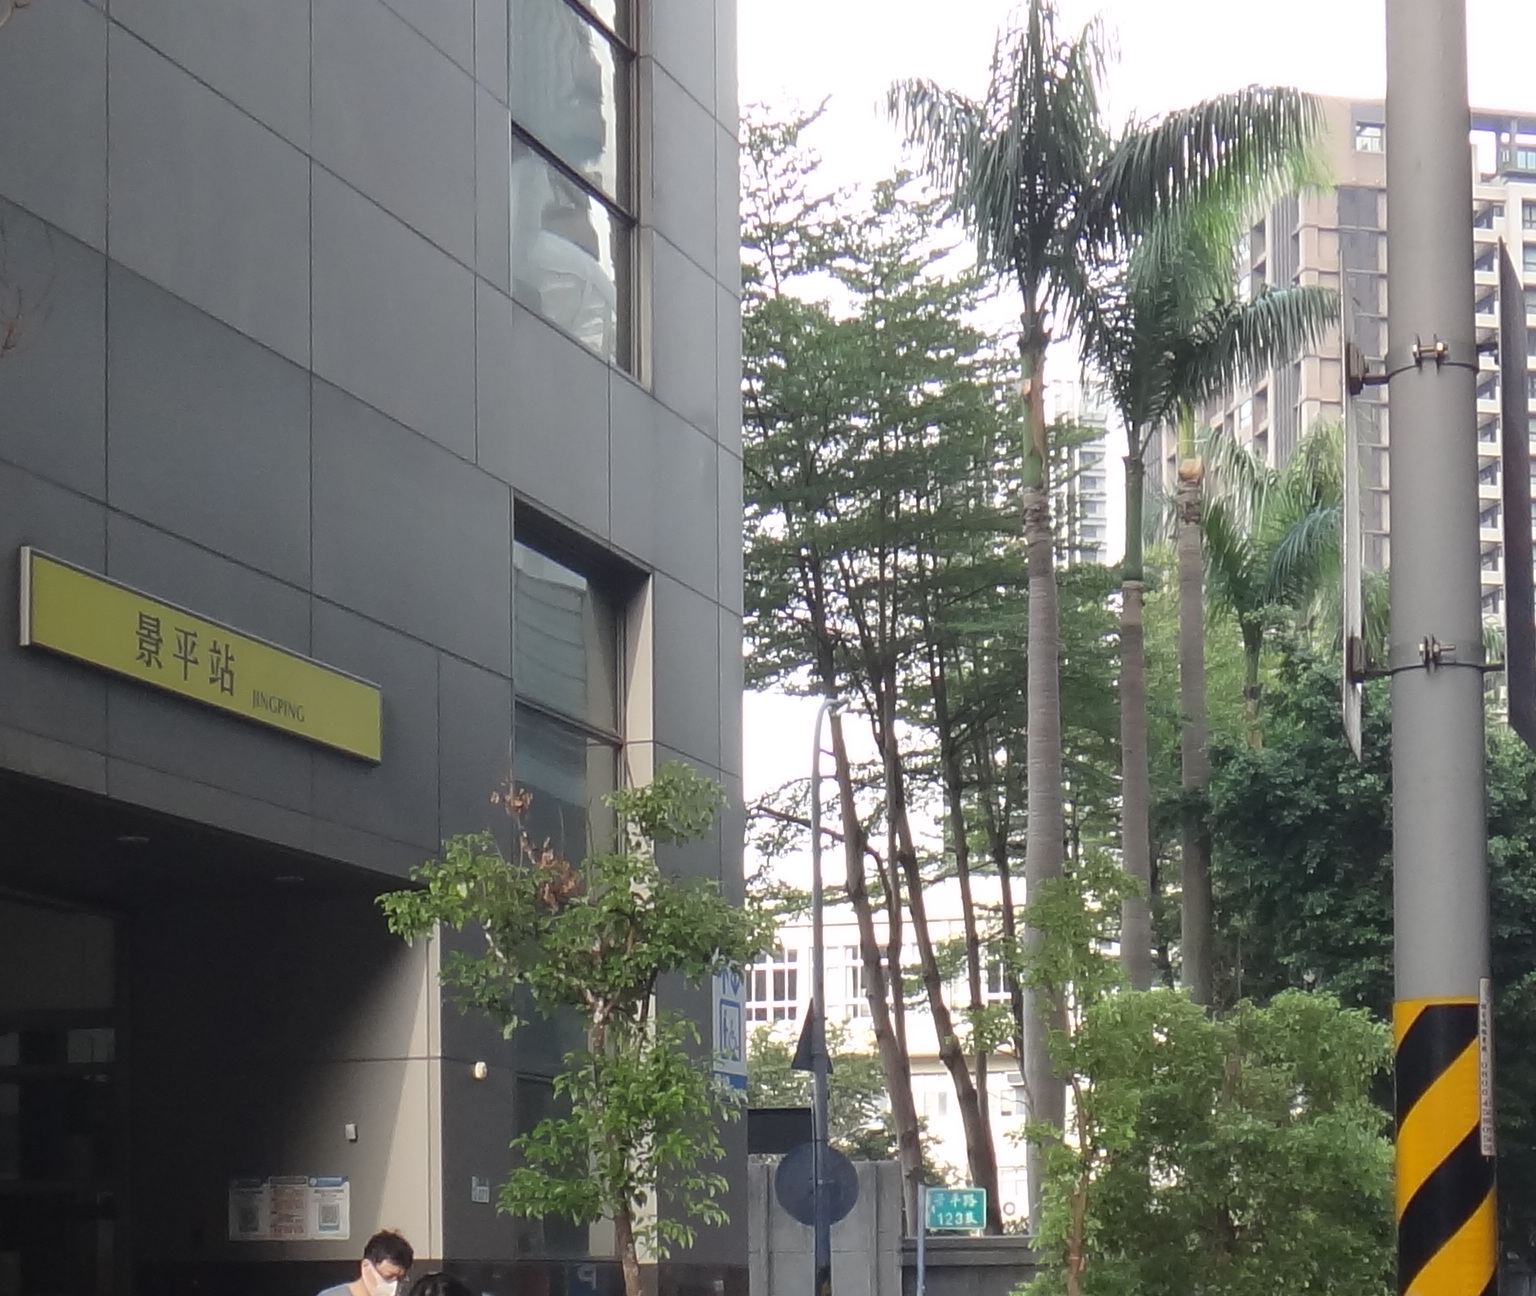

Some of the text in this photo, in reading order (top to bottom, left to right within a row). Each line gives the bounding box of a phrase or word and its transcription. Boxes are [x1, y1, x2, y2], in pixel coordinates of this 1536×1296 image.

[135, 610, 235, 697] 景平站
[251, 689, 306, 723] JINGPING
